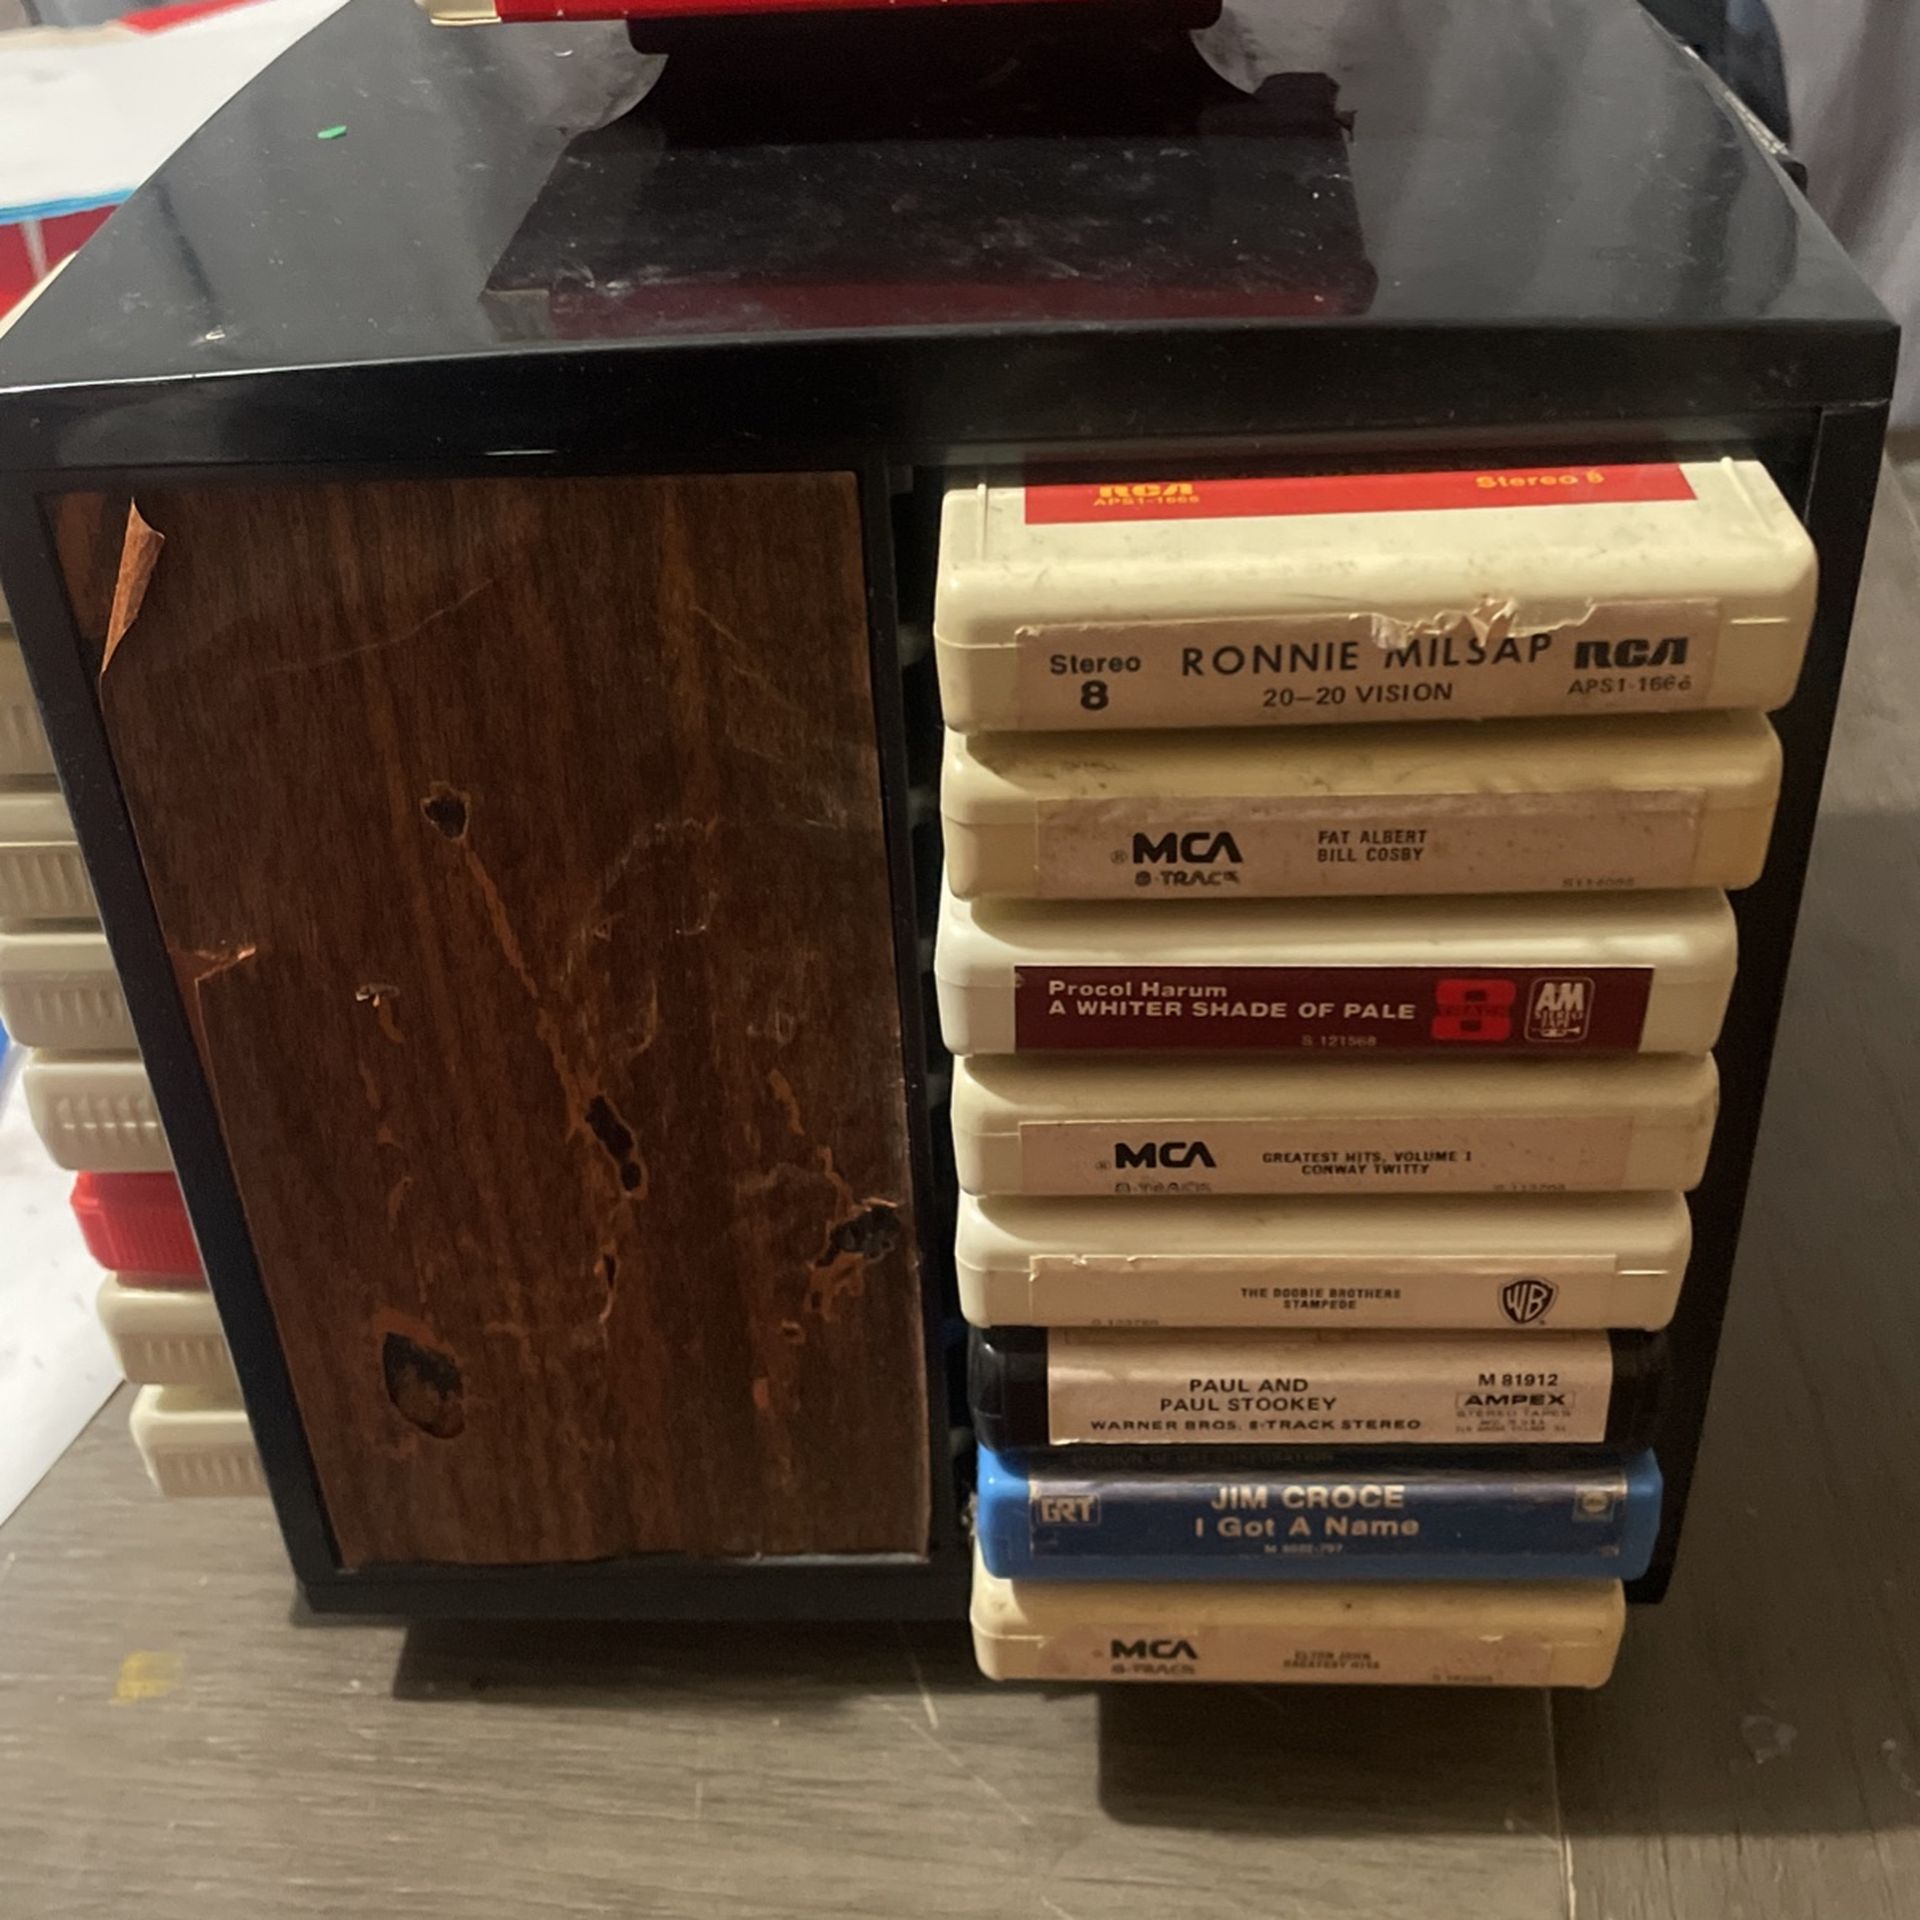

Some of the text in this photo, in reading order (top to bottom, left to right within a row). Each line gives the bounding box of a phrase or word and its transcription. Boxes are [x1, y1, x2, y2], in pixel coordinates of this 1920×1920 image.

[1475, 475, 1579, 489] Stereo
[1099, 483, 1193, 497] RCA
[1050, 634, 1689, 677] Stereo RONNIE MILSAP RCA
[1080, 680, 1110, 711] 8
[1355, 682, 1453, 703] VISION
[1132, 829, 1427, 864] MCA FAT ALBERT
[1317, 847, 1424, 862] BILL COSBY
[1048, 980, 1227, 998] Procol Harum
[1048, 1000, 1066, 1015] A
[1076, 1001, 1183, 1016] WHITER
[1192, 1002, 1288, 1018] SHADE
[1298, 1002, 1335, 1018] OF
[1343, 1003, 1417, 1019] PALE
[1114, 1141, 1217, 1168] MCA
[1262, 1152, 1340, 1164] GREATEST
[1395, 1150, 1457, 1162] VOLUME
[1301, 1163, 1430, 1175] CONWAY TWITTY
[1241, 1288, 1402, 1299] THE DOOBIE BROTHERS
[1283, 1300, 1357, 1310] STAMPEDE
[1189, 1378, 1309, 1393] PAUL AND
[1478, 1374, 1559, 1387] M 81912
[1160, 1397, 1337, 1412] PAUL STOOKEY
[1464, 1394, 1566, 1406] AMPEX
[1091, 1420, 1178, 1431] WARNER
[1340, 1419, 1422, 1431] STEREO
[1211, 1484, 1406, 1510] JIM CROCE
[1041, 1496, 1094, 1522] GRT
[1195, 1516, 1420, 1537] I Got A Name
[1110, 1640, 1198, 1660] MCA
